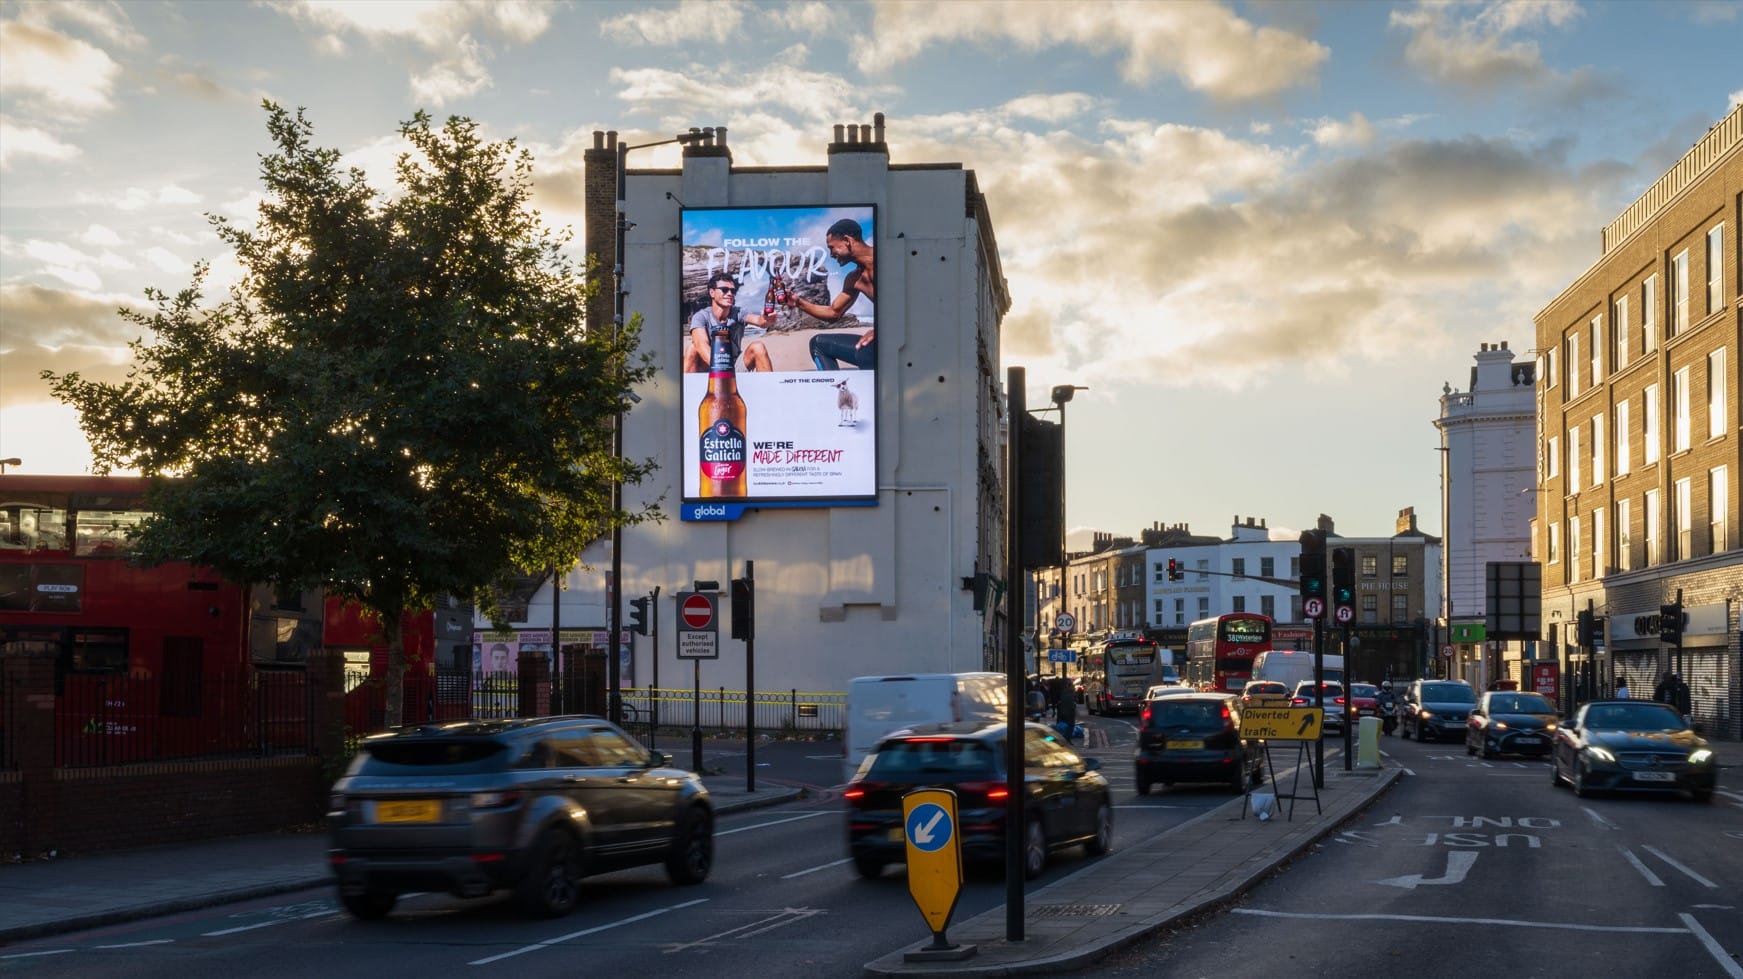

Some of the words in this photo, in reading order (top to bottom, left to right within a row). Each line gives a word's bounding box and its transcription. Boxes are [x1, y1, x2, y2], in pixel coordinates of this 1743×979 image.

[724, 238, 780, 247] FOLLOW
[784, 237, 812, 246] THE
[704, 438, 742, 450] Estrella
[753, 441, 794, 450] WE'RE
[704, 450, 741, 462] Galicia
[753, 450, 782, 464] MADE
[694, 506, 726, 519] global
[1379, 582, 1409, 590] HOUSE
[1058, 618, 1073, 627] 20
[1245, 710, 1290, 719] Diverted
[1244, 727, 1277, 736] traffic
